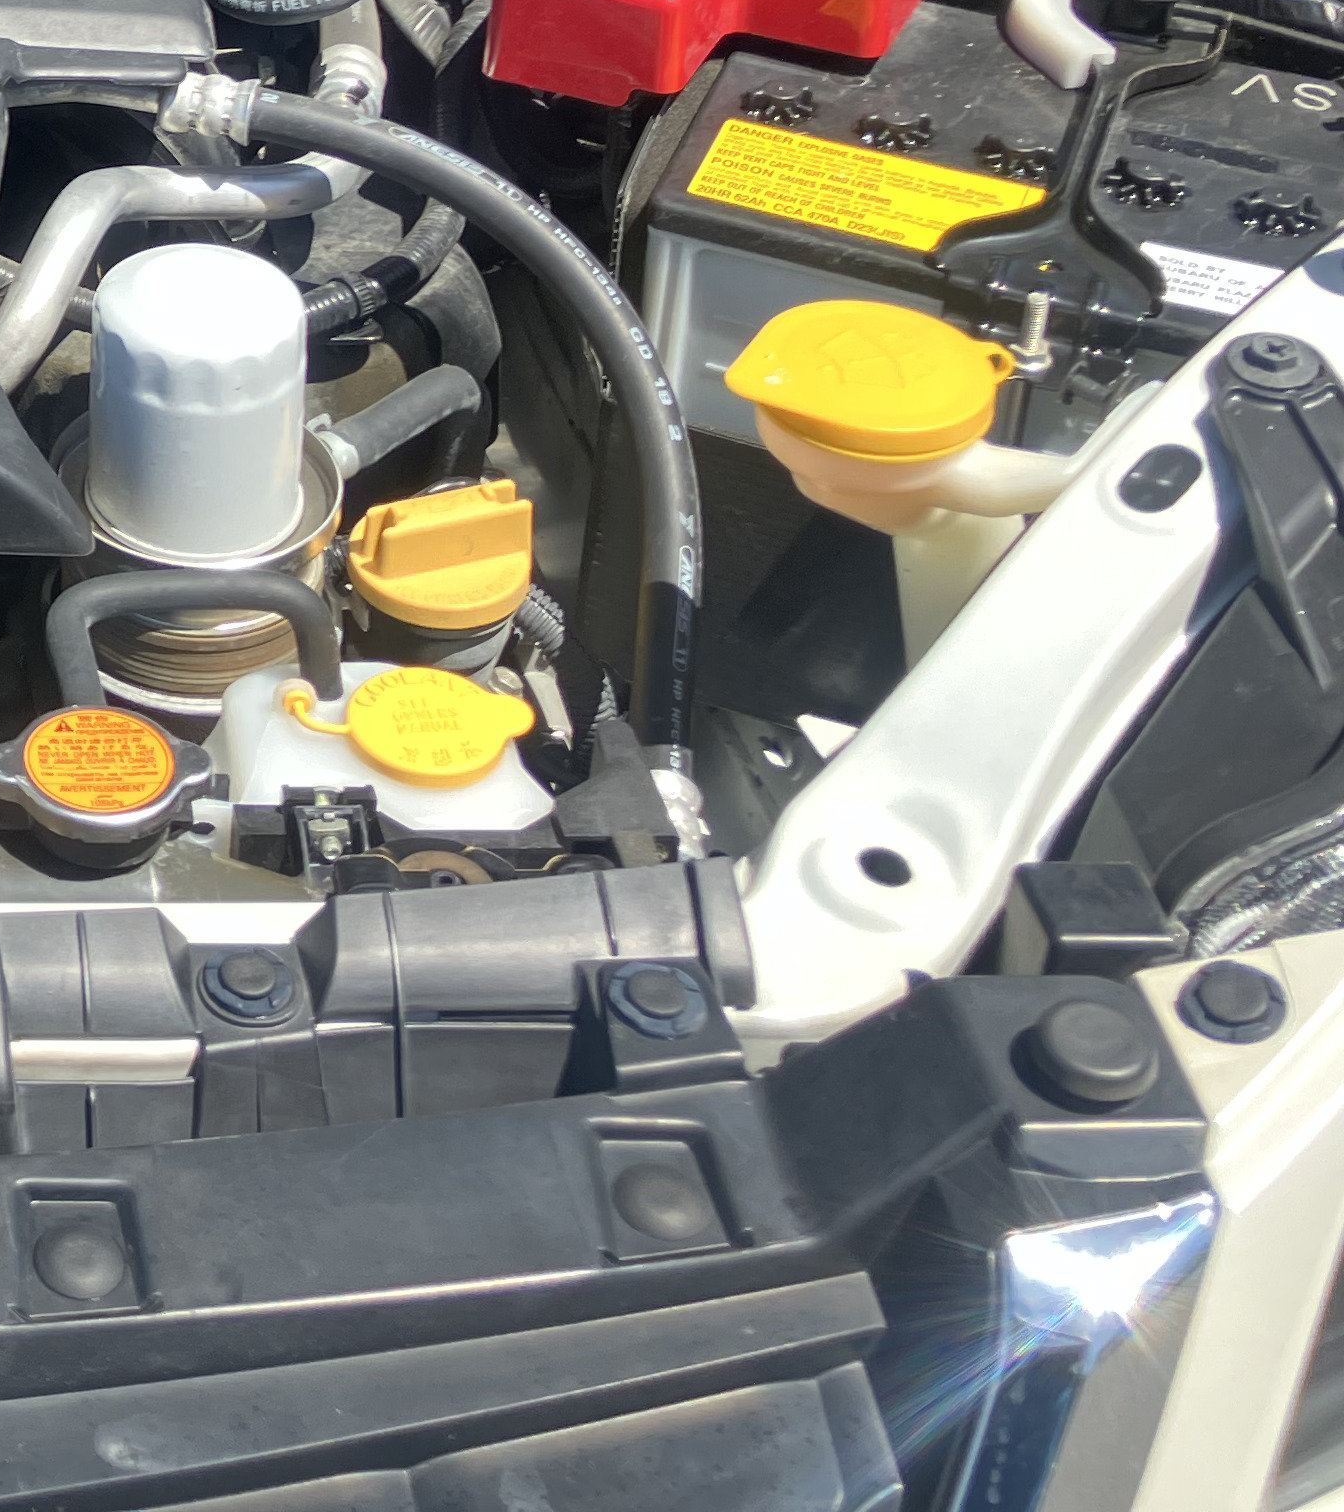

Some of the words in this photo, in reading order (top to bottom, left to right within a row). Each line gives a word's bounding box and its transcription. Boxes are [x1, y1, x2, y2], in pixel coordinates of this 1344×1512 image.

[728, 124, 794, 145] DANGER
[798, 141, 848, 158] EXPLOSIVE
[710, 157, 775, 178] POISON
[778, 174, 817, 188] CAUSES
[769, 160, 796, 171] CAPS
[527, 204, 551, 224] HP
[773, 203, 803, 217] CCA
[1159, 255, 1198, 268] SOLD
[1206, 265, 1226, 274] BY
